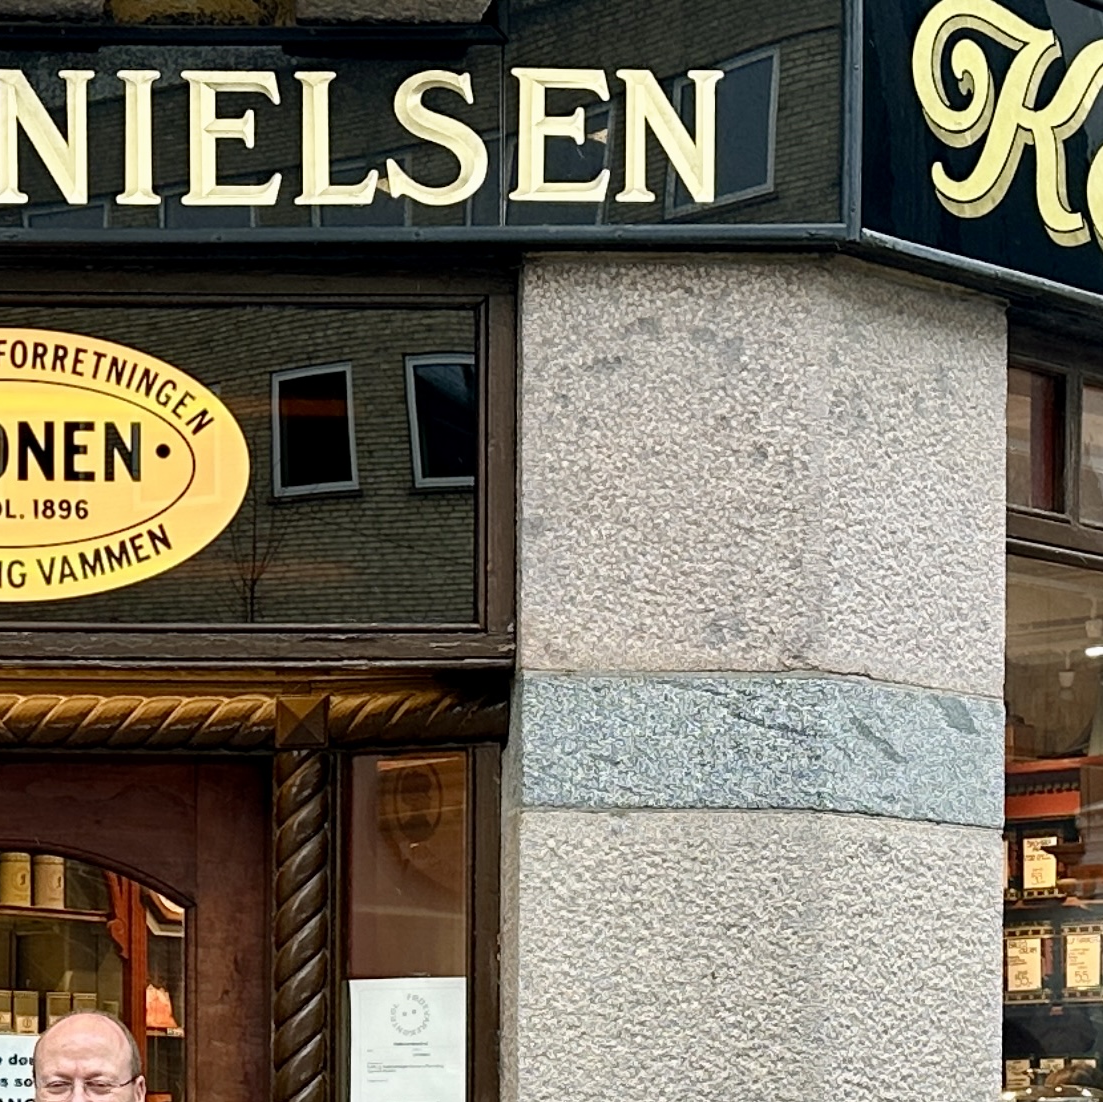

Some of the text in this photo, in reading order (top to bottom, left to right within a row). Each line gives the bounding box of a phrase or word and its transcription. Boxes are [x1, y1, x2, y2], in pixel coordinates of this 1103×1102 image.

[912, 0, 1103, 252] K
[32, 499, 90, 520] 1896
[36, 523, 173, 585] VAMMEN
[14, 1078, 35, 1087] so
